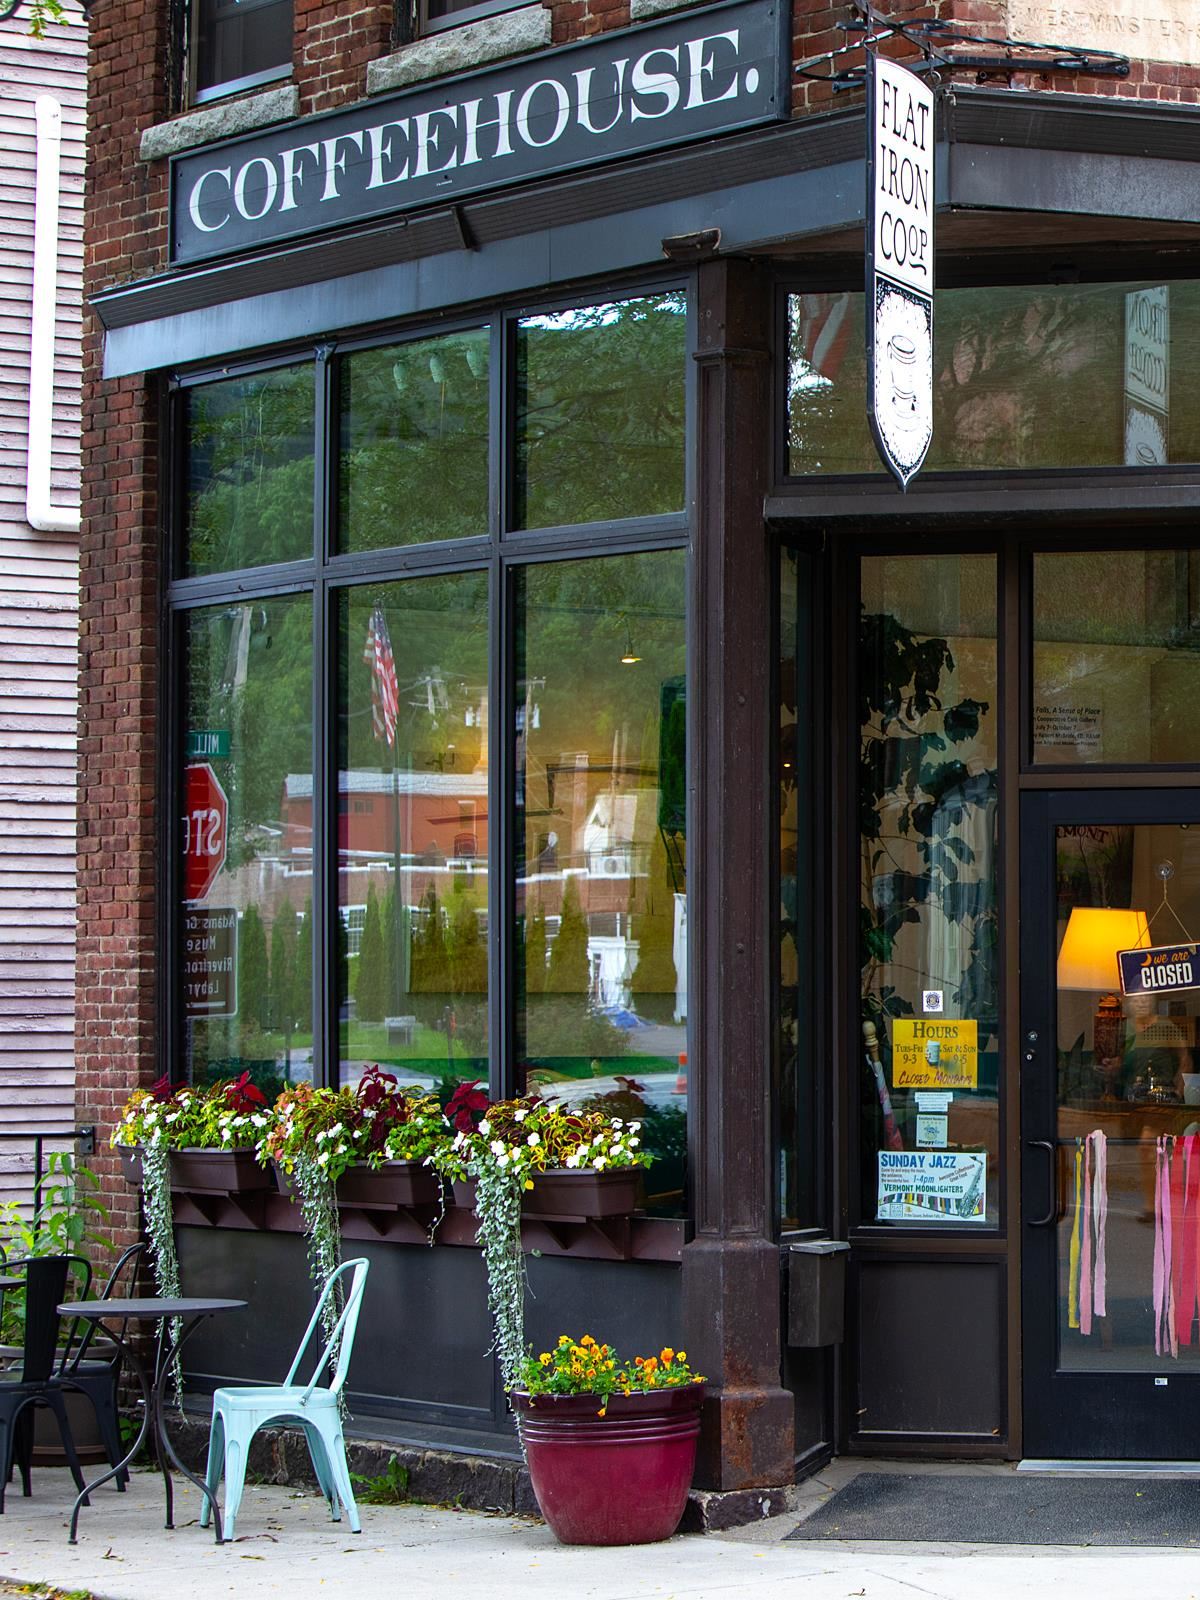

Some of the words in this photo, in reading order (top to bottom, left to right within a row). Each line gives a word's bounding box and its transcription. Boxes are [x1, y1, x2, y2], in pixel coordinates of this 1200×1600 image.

[881, 78, 930, 151] FLAT
[189, 29, 760, 233] COFFEEHOUSE.
[880, 143, 929, 216] IRON
[880, 210, 928, 267] COOP
[1153, 953, 1168, 964] we
[1171, 950, 1190, 961] are
[1141, 962, 1193, 988] CLOSED
[903, 1053, 917, 1064] 9-3
[881, 1153, 925, 1168] SUNDAY
[929, 1155, 957, 1169] JAZZ
[913, 1175, 935, 1185] 1-4pm
